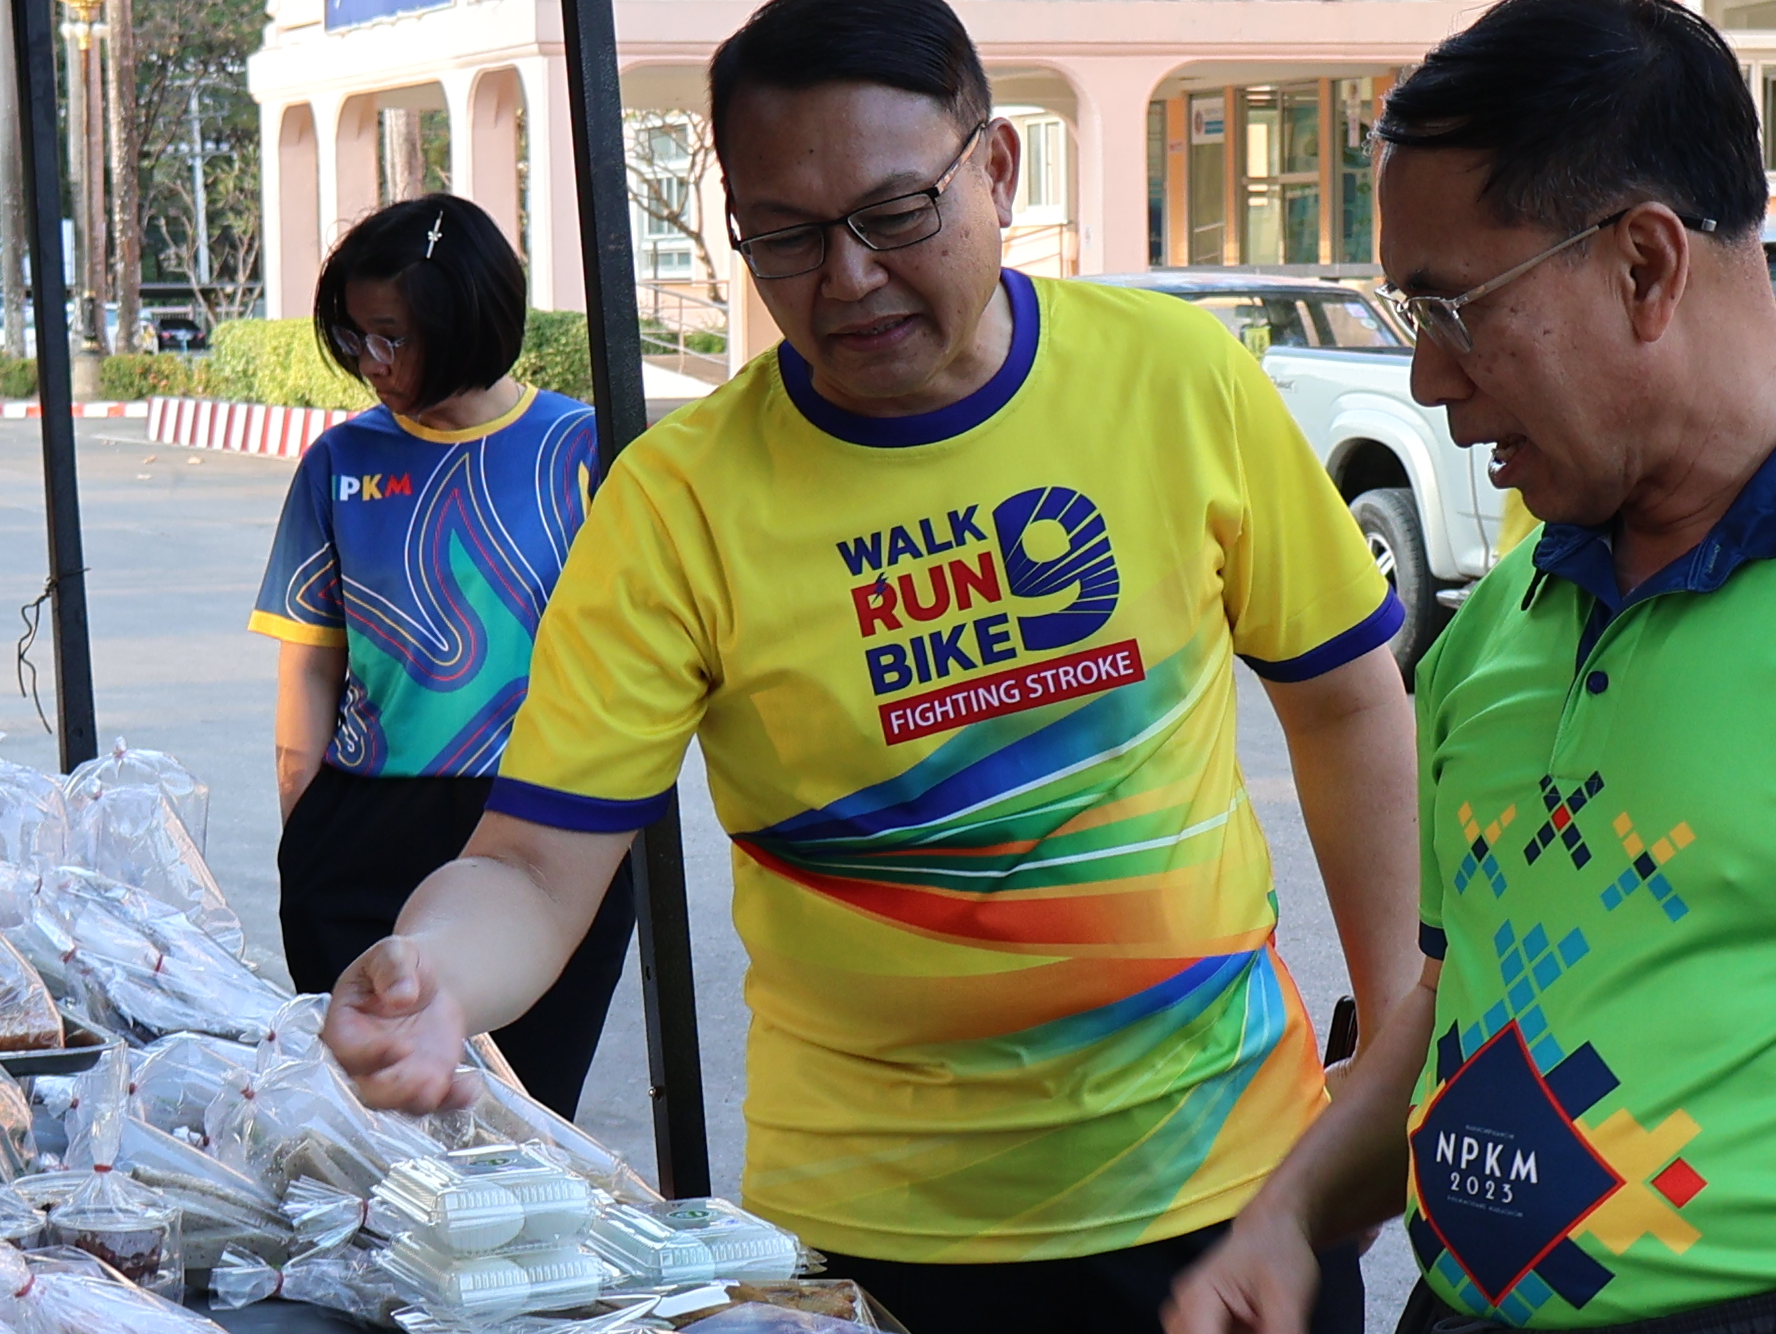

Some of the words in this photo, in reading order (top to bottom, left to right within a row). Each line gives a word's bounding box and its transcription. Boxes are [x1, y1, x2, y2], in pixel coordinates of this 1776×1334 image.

[836, 503, 988, 577] WALK
[850, 550, 1003, 638] RUN
[991, 486, 1120, 651] 9
[865, 612, 1017, 696] BIKE
[889, 679, 1022, 735] FIGHTING
[1025, 650, 1135, 699] STROKE
[1436, 1130, 1538, 1185] NPKM
[1450, 1171, 1514, 1204] 2023
